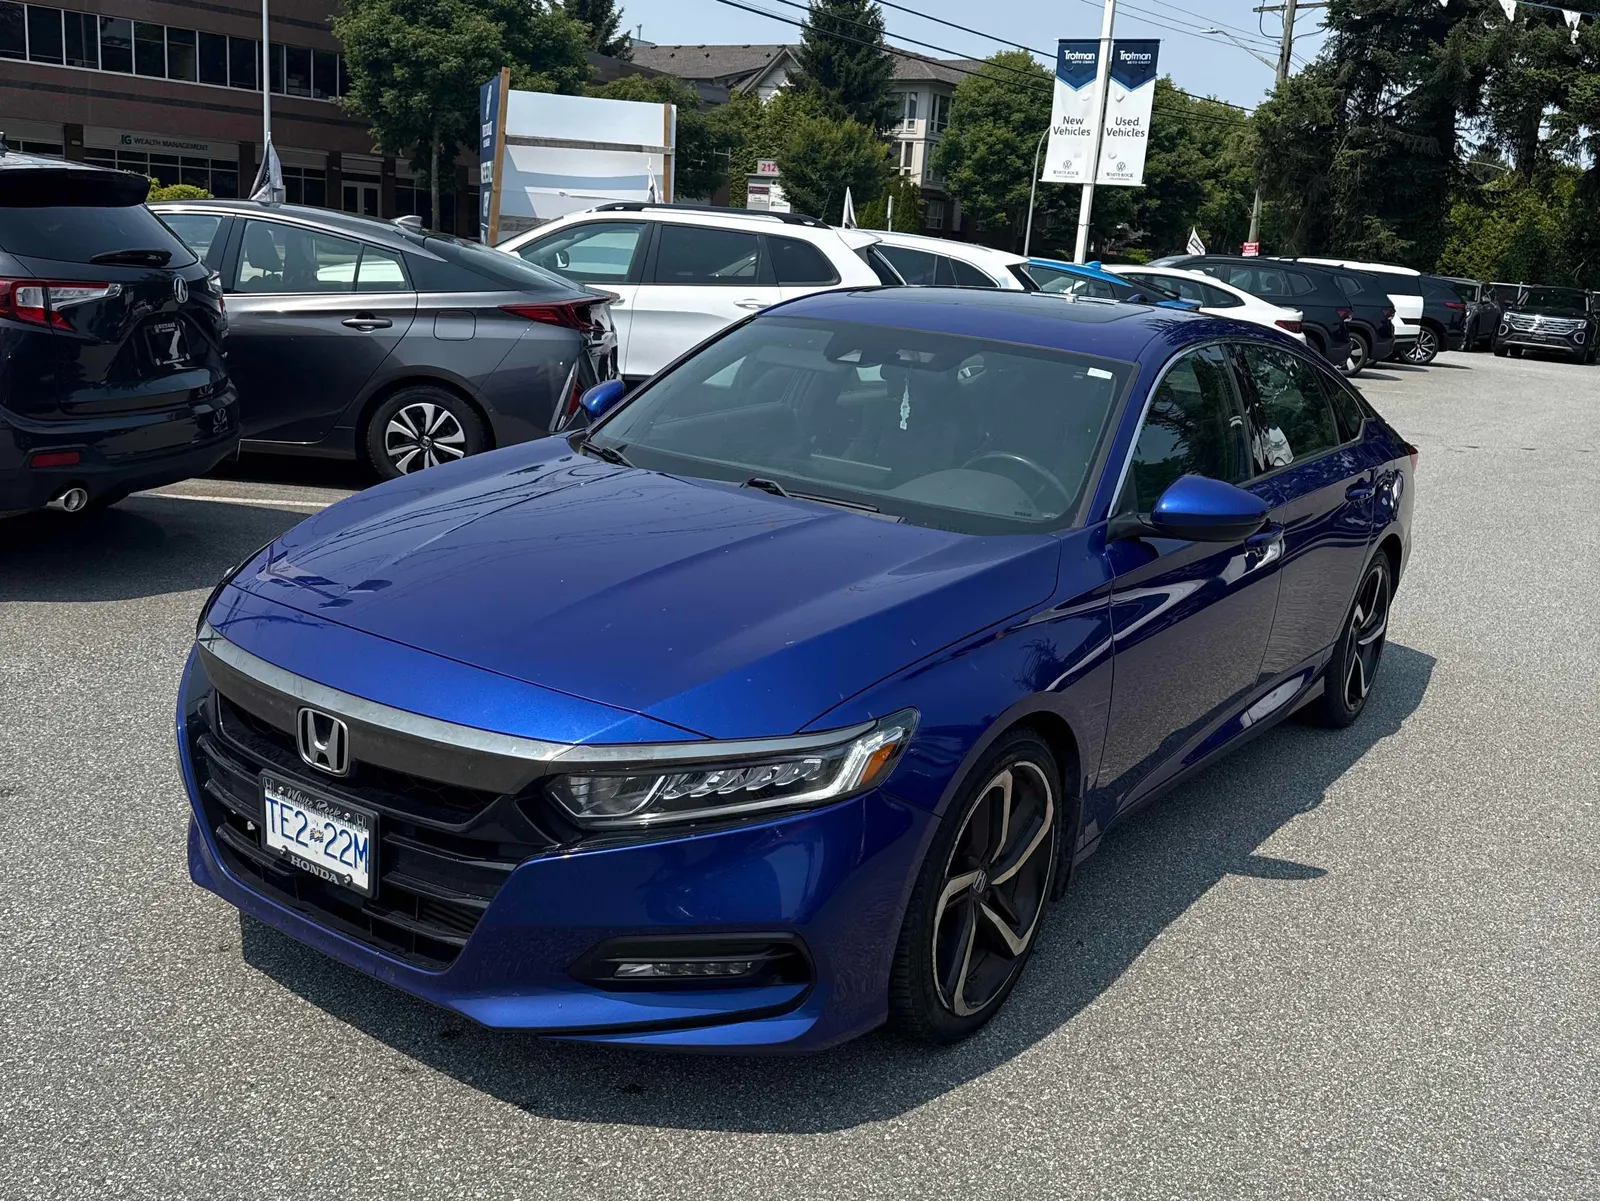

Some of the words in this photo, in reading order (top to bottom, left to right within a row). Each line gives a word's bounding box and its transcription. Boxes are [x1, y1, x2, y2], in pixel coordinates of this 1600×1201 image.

[1064, 50, 1095, 60] Trotman
[1119, 50, 1151, 61] Trotman
[1062, 116, 1084, 125] New
[1115, 117, 1140, 126] Used
[1053, 126, 1091, 136] Vehicles
[1106, 127, 1146, 138] Vehicles
[121, 134, 132, 145] IG
[133, 137, 160, 146] WEALTH
[162, 140, 210, 151] MANAGEMENT
[286, 787, 315, 808] White
[315, 799, 341, 817] Rock
[265, 796, 309, 848] TE2
[324, 821, 369, 874] 22M
[290, 854, 340, 886] HONDA
